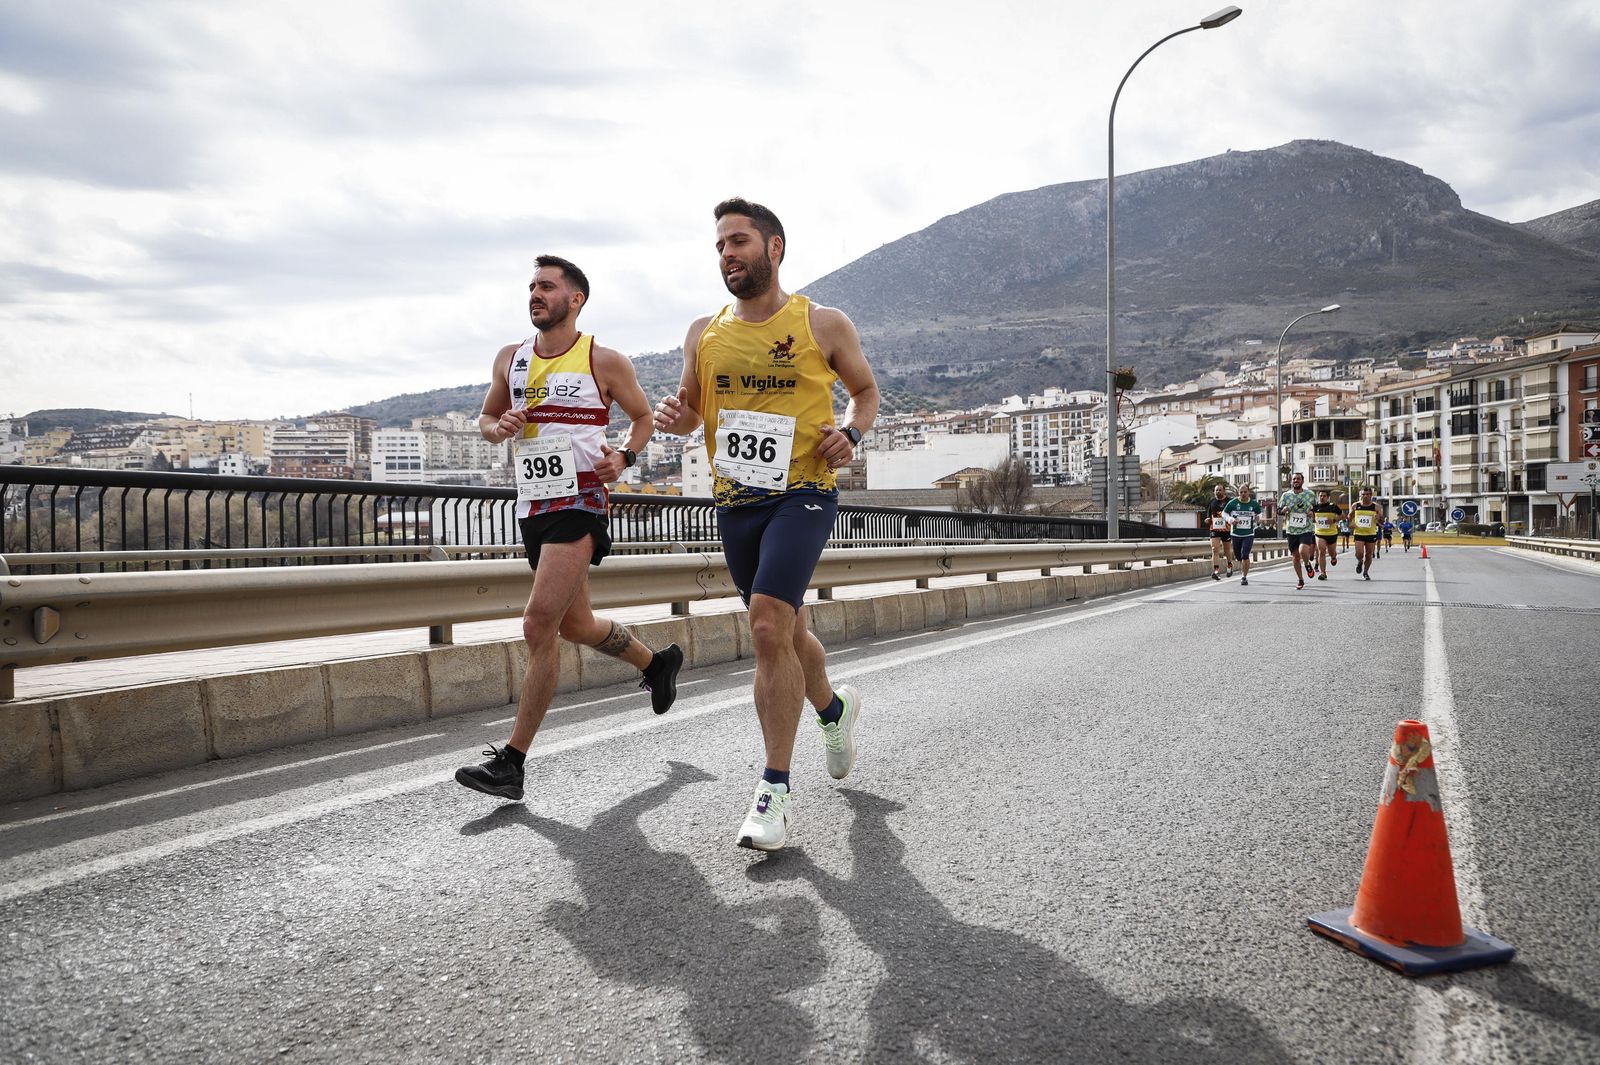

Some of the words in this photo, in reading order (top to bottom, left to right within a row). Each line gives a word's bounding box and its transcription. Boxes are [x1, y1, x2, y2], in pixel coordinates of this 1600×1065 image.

[740, 375, 796, 391] Vigilsa
[727, 432, 777, 463] 836
[522, 455, 564, 480] 398
